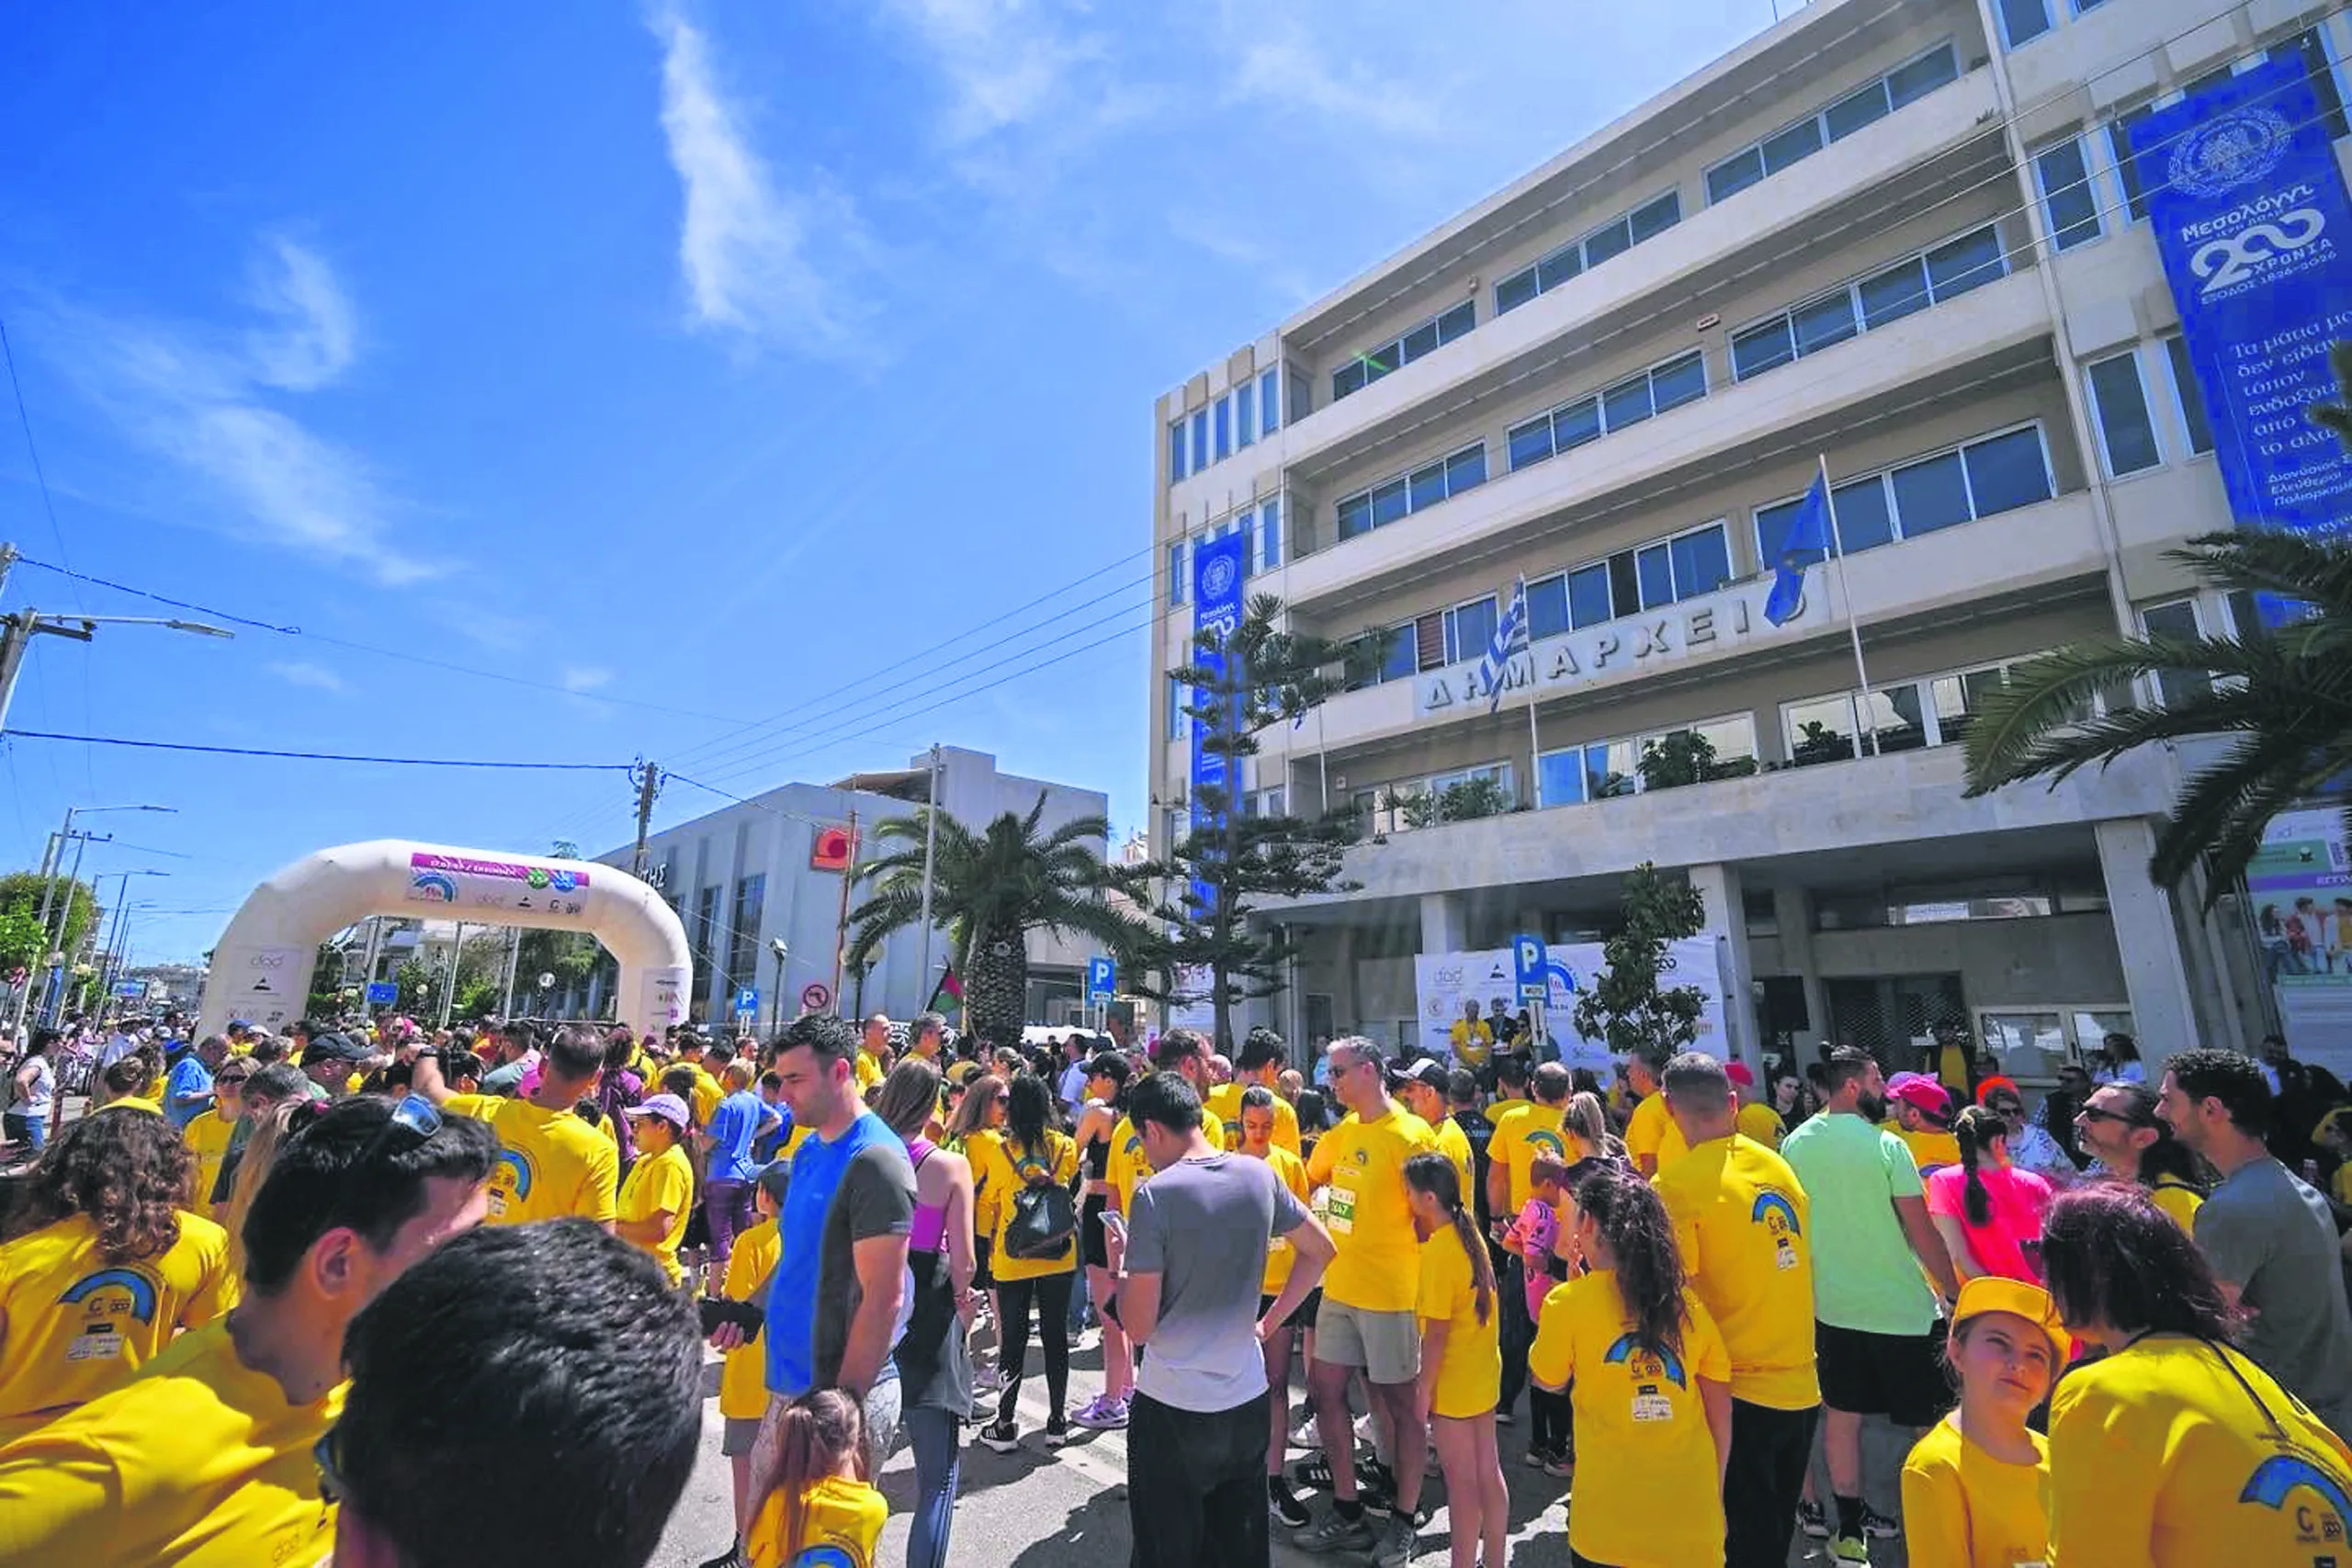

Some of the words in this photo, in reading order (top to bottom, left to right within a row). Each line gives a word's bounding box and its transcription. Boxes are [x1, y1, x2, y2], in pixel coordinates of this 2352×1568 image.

[2181, 184, 2315, 243] Μεσολόγγι
[2190, 208, 2325, 295] 200
[2253, 238, 2333, 276] ΧΡΟΝΙΑ
[2237, 357, 2274, 378] δεν
[1521, 942, 1540, 973] P
[1095, 963, 1110, 985] P
[741, 990, 754, 1006] P
